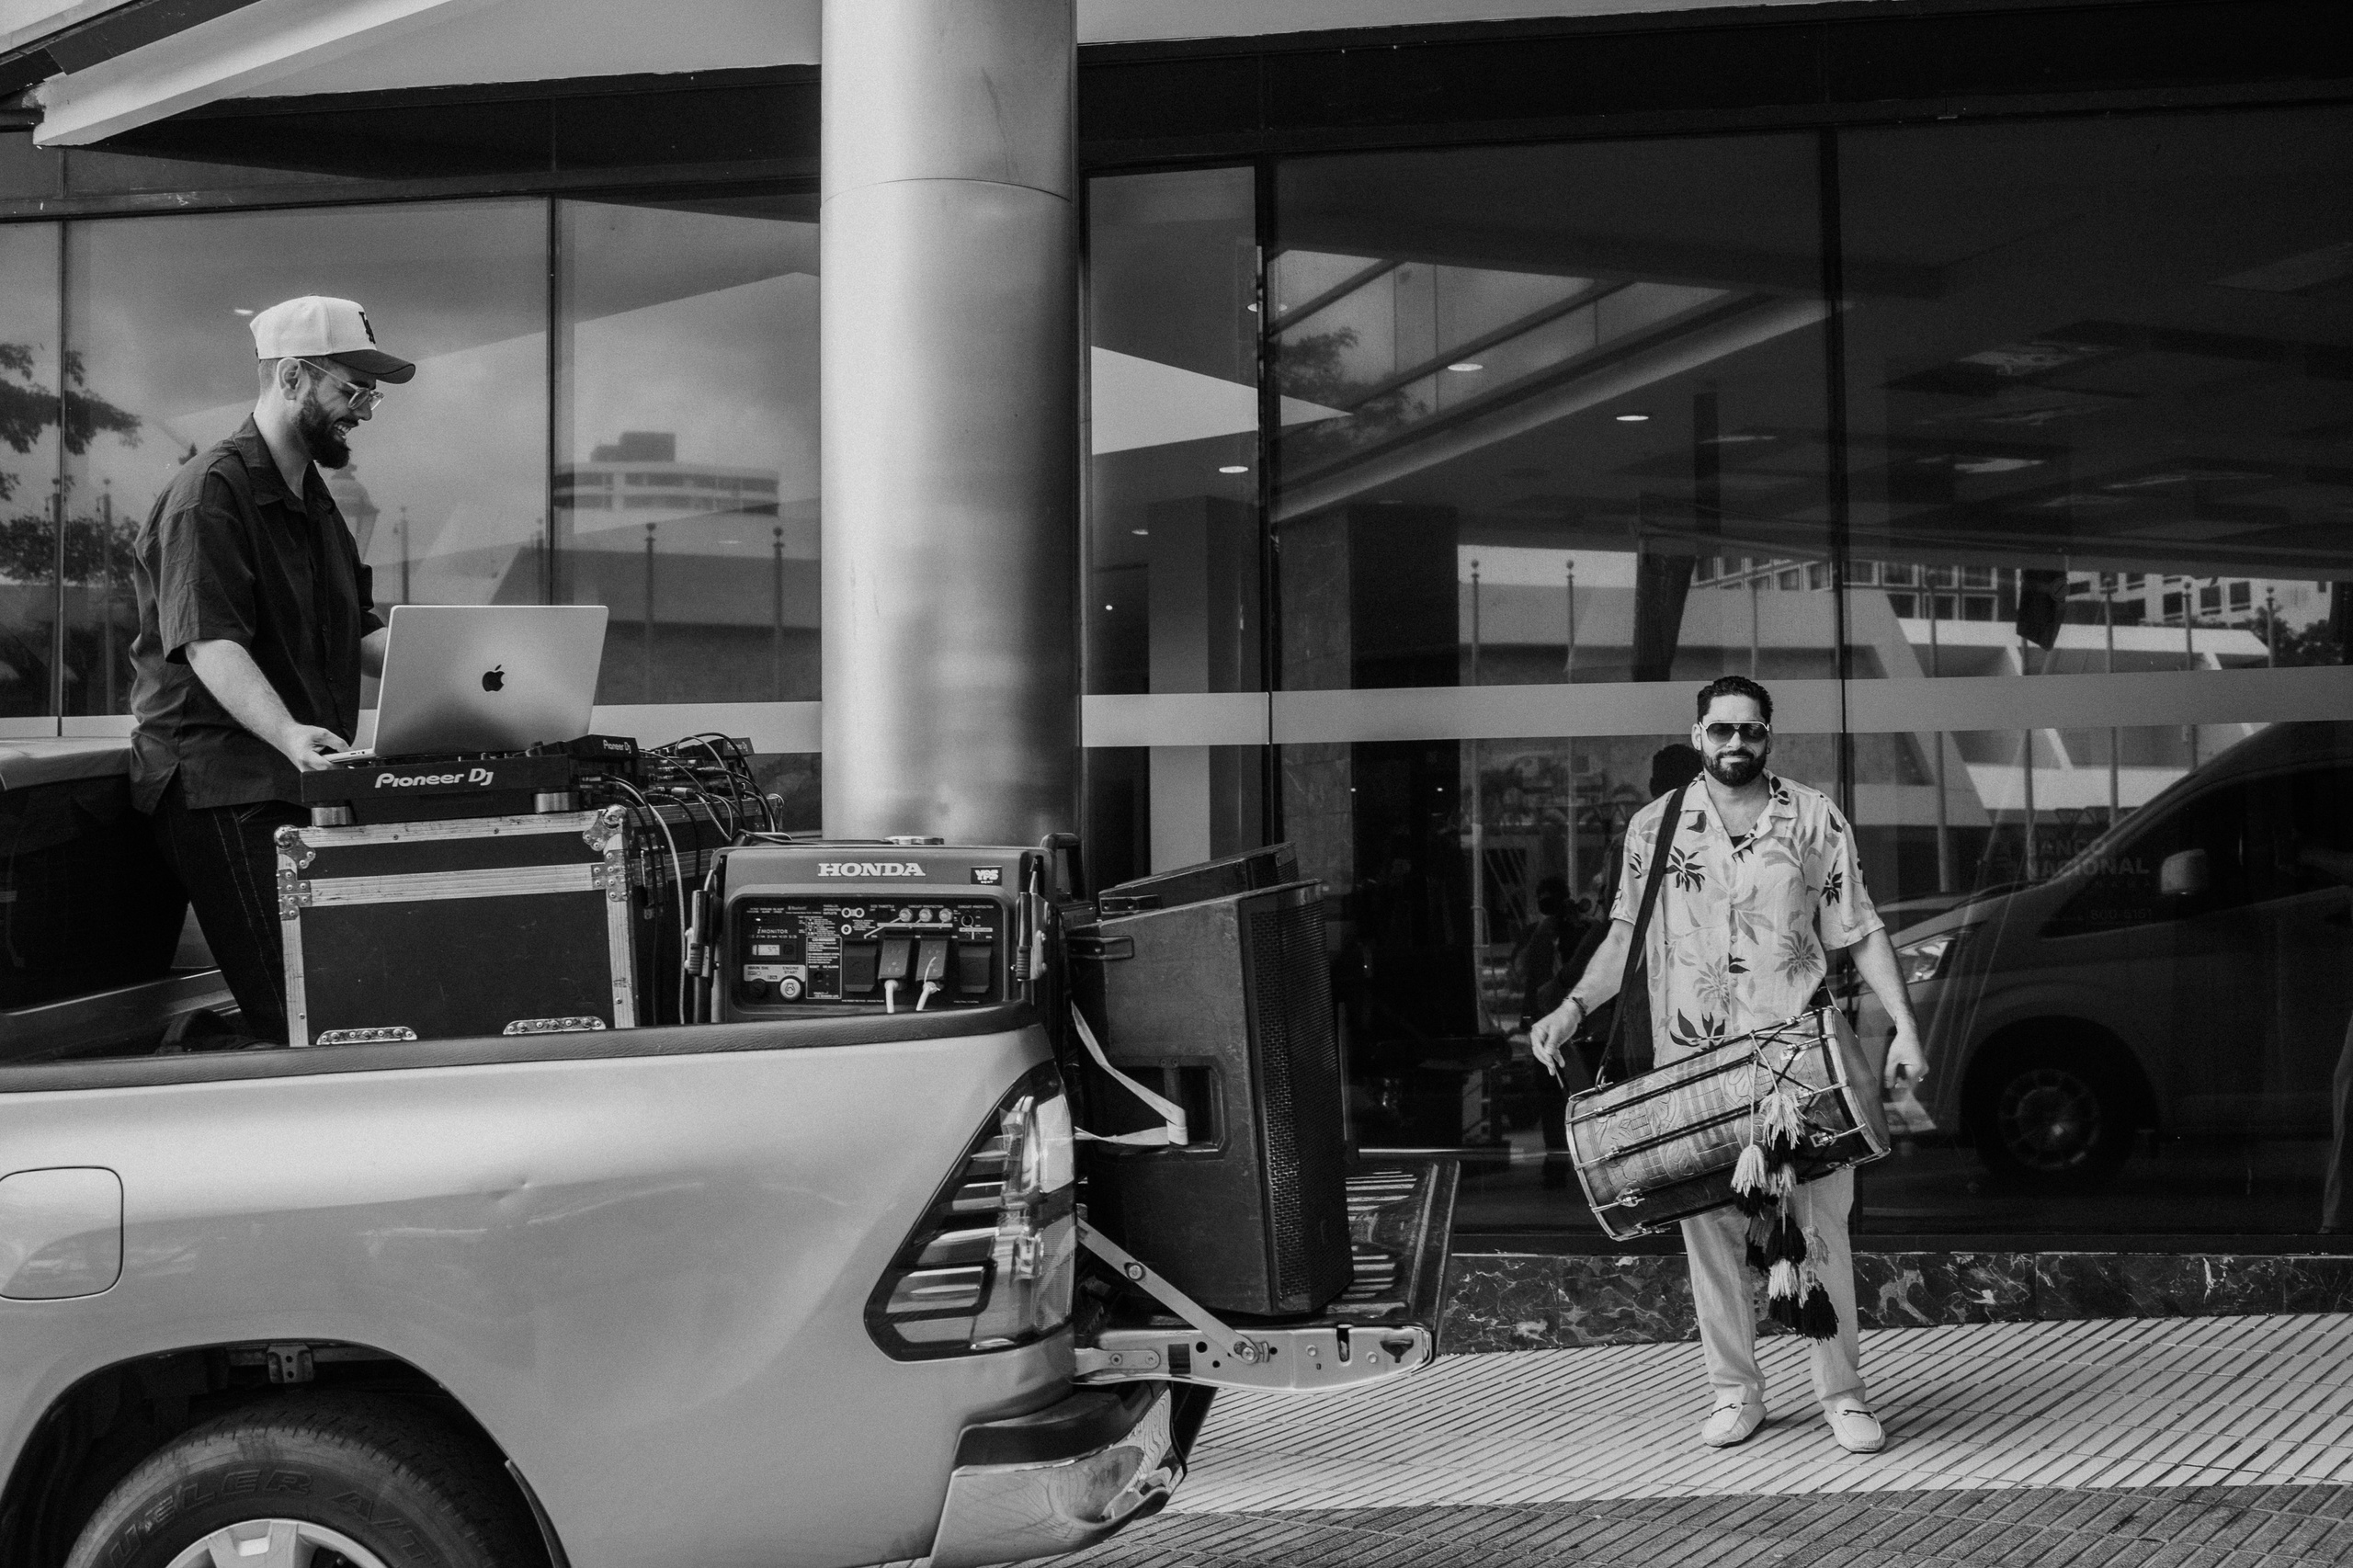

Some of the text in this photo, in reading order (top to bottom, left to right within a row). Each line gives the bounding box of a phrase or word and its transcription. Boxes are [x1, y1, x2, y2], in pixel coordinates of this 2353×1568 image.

[603, 739, 624, 750] Pioneer
[374, 772, 465, 789] Pioneer
[817, 862, 926, 877] HONDA
[2028, 858, 2151, 876] AIONAL
[974, 869, 999, 881] YPS
